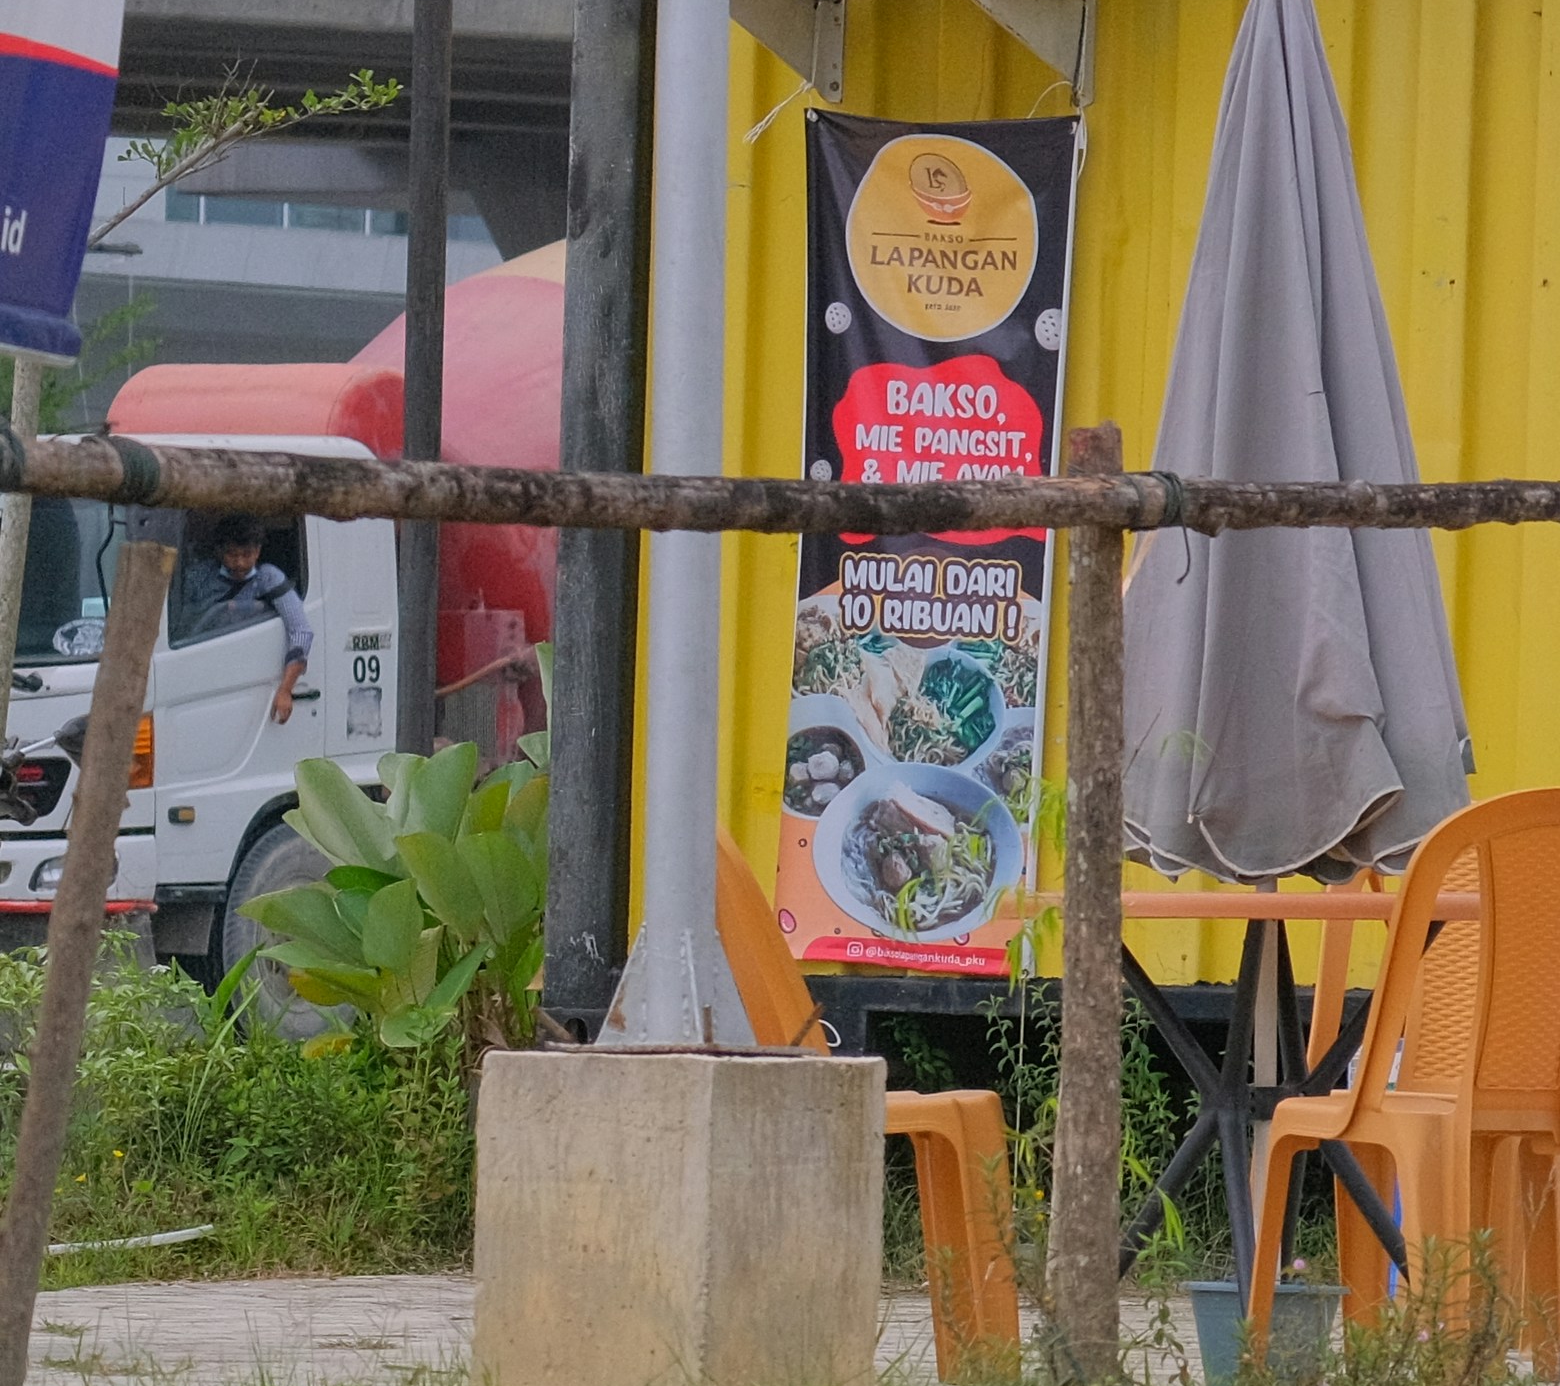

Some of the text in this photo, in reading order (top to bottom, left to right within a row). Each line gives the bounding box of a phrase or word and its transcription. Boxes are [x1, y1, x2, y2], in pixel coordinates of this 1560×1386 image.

[924, 232, 964, 244] BAKSO
[870, 245, 1018, 271] LAPANGAN
[906, 273, 984, 297] KUDA
[886, 380, 1006, 426] BAKSO,
[855, 423, 1033, 463] MIE PANGSIT,
[861, 458, 884, 484] &
[844, 559, 1016, 598] MULAI DARI
[842, 594, 872, 627] 10
[883, 599, 995, 634] RIBUAN
[353, 654, 380, 683] 09
